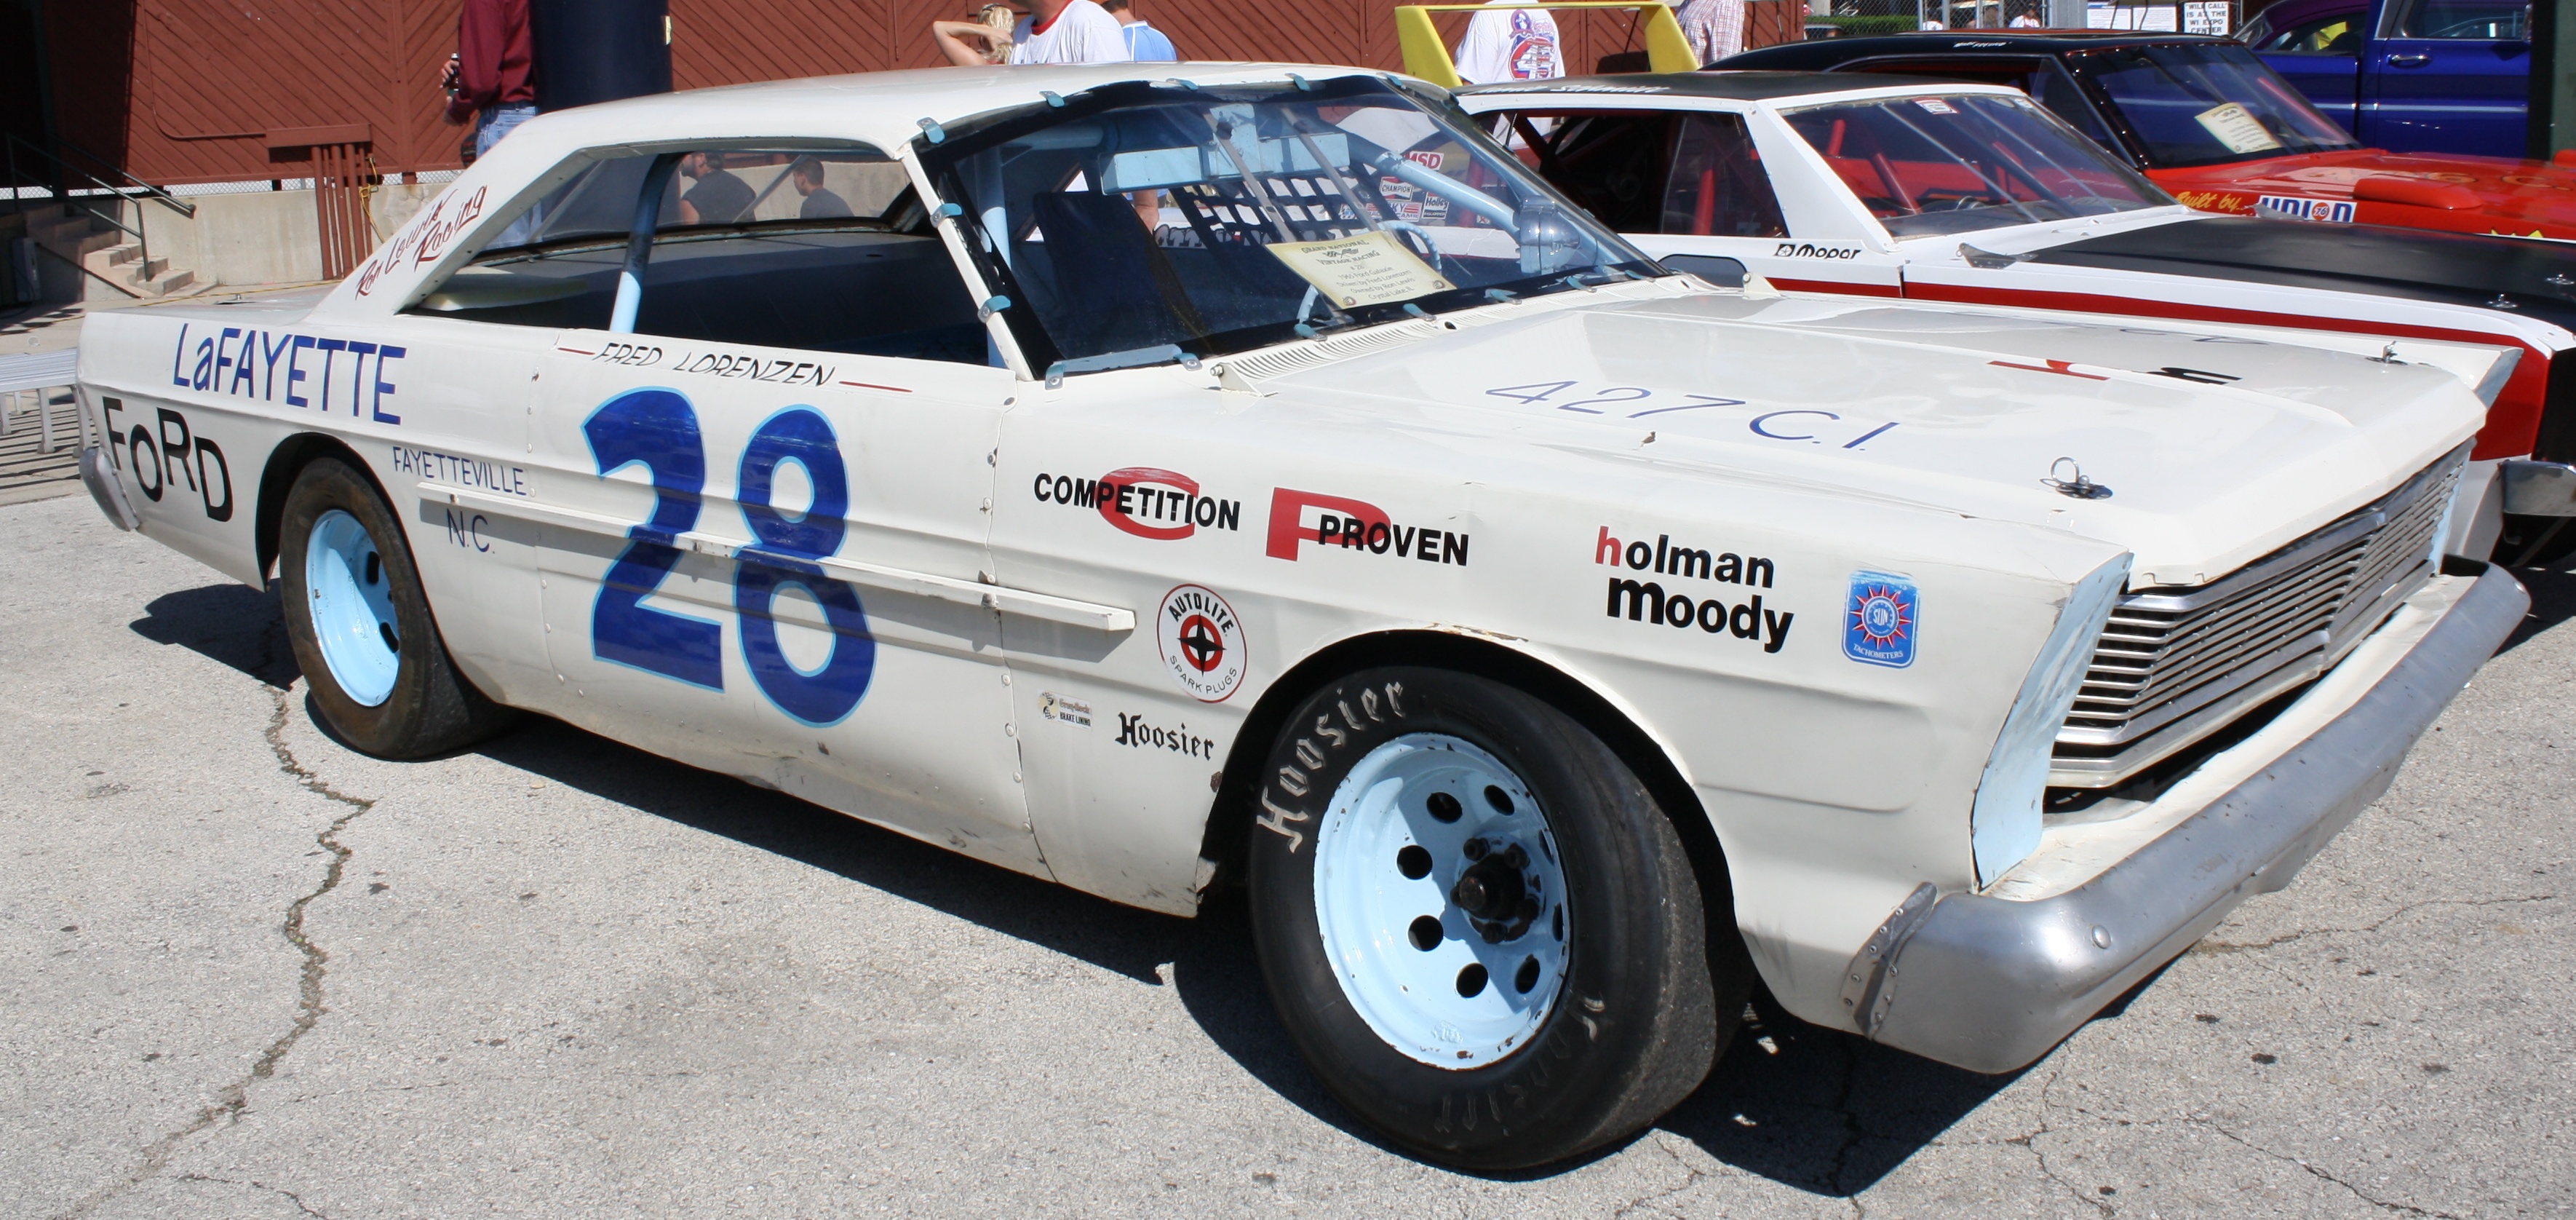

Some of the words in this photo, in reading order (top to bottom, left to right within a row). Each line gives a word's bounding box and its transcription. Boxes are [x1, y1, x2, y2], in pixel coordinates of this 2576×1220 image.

[1382, 184, 1412, 193] CHAMPION
[2313, 207, 2328, 216] 76
[355, 259, 384, 301] Ron
[385, 189, 458, 274] Lewis
[413, 185, 488, 272] Racing
[173, 322, 408, 425] LaFAYETTE
[592, 341, 663, 367] FRED
[672, 351, 836, 387] LORENZEN
[1484, 380, 1747, 419] 427
[103, 396, 234, 523] FORD
[392, 445, 528, 496] FAYETTEVILLE
[446, 508, 496, 555] N.C.
[1033, 472, 1241, 532] COMPETITION
[1318, 514, 1469, 566] PROVEN
[581, 385, 878, 728] 28
[1594, 525, 1775, 589] holman
[1606, 577, 1794, 654] moody
[1872, 608, 1889, 626] SUN
[1169, 655, 1202, 693] SPARK
[1205, 667, 1238, 694] PLUGS
[1853, 643, 1904, 659] TACHOMETERS
[1114, 711, 1215, 761] Hoosier
[1256, 678, 1405, 855] Hoosier
